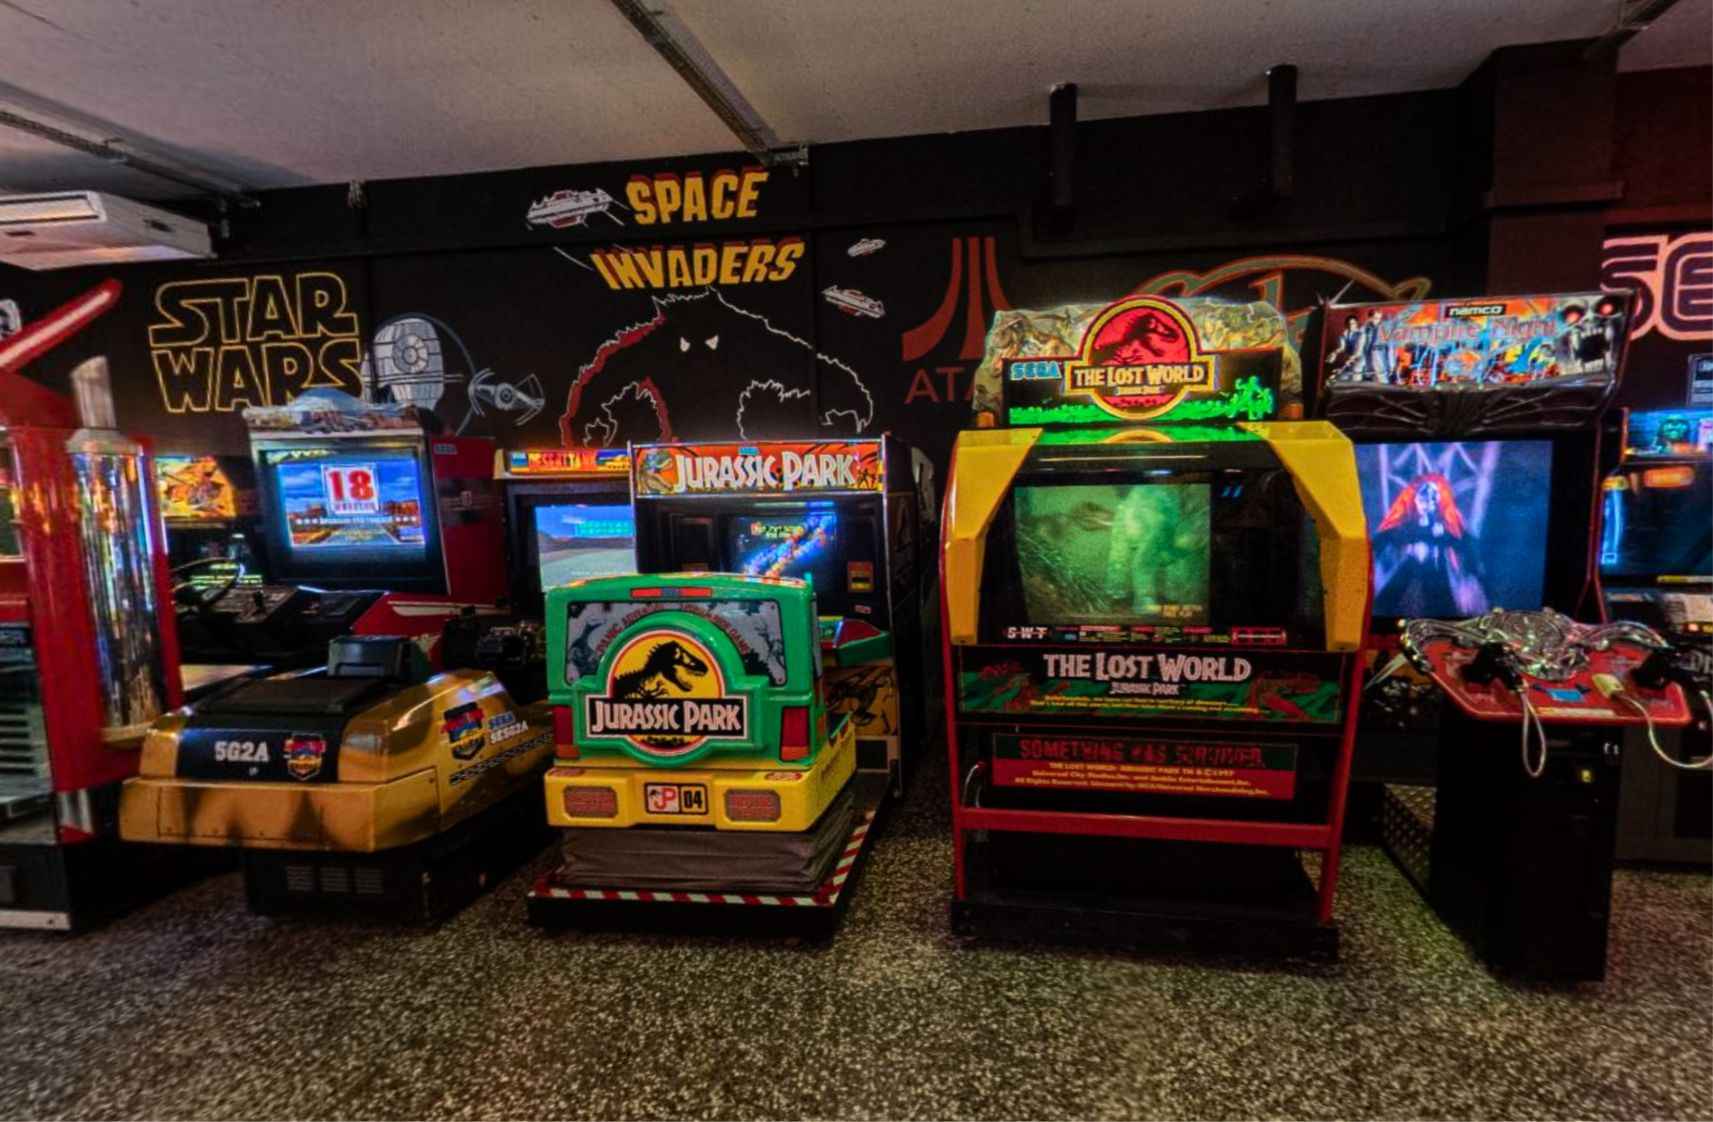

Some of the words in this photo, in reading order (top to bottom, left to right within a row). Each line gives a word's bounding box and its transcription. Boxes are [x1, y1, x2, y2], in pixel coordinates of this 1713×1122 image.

[626, 168, 768, 225] SPACE
[591, 236, 805, 290] INVADERS
[148, 272, 359, 347] STAR
[1449, 304, 1505, 318] namco
[151, 338, 365, 413] WARS
[904, 368, 977, 404] AT
[1010, 361, 1062, 380] SEGA
[1074, 369, 1105, 386] THE
[1107, 366, 1144, 387] LOST
[1145, 365, 1205, 385] WORLD
[329, 470, 375, 502] 18
[672, 454, 776, 493] JURASSIC
[782, 451, 857, 491] PARK
[1043, 655, 1091, 677] THE
[1095, 652, 1153, 682] LOST
[1157, 653, 1252, 682] WORLD
[1152, 682, 1179, 695] PARK
[591, 701, 680, 733] JURASSIC
[683, 701, 741, 733] PARK
[684, 791, 702, 808] 04
